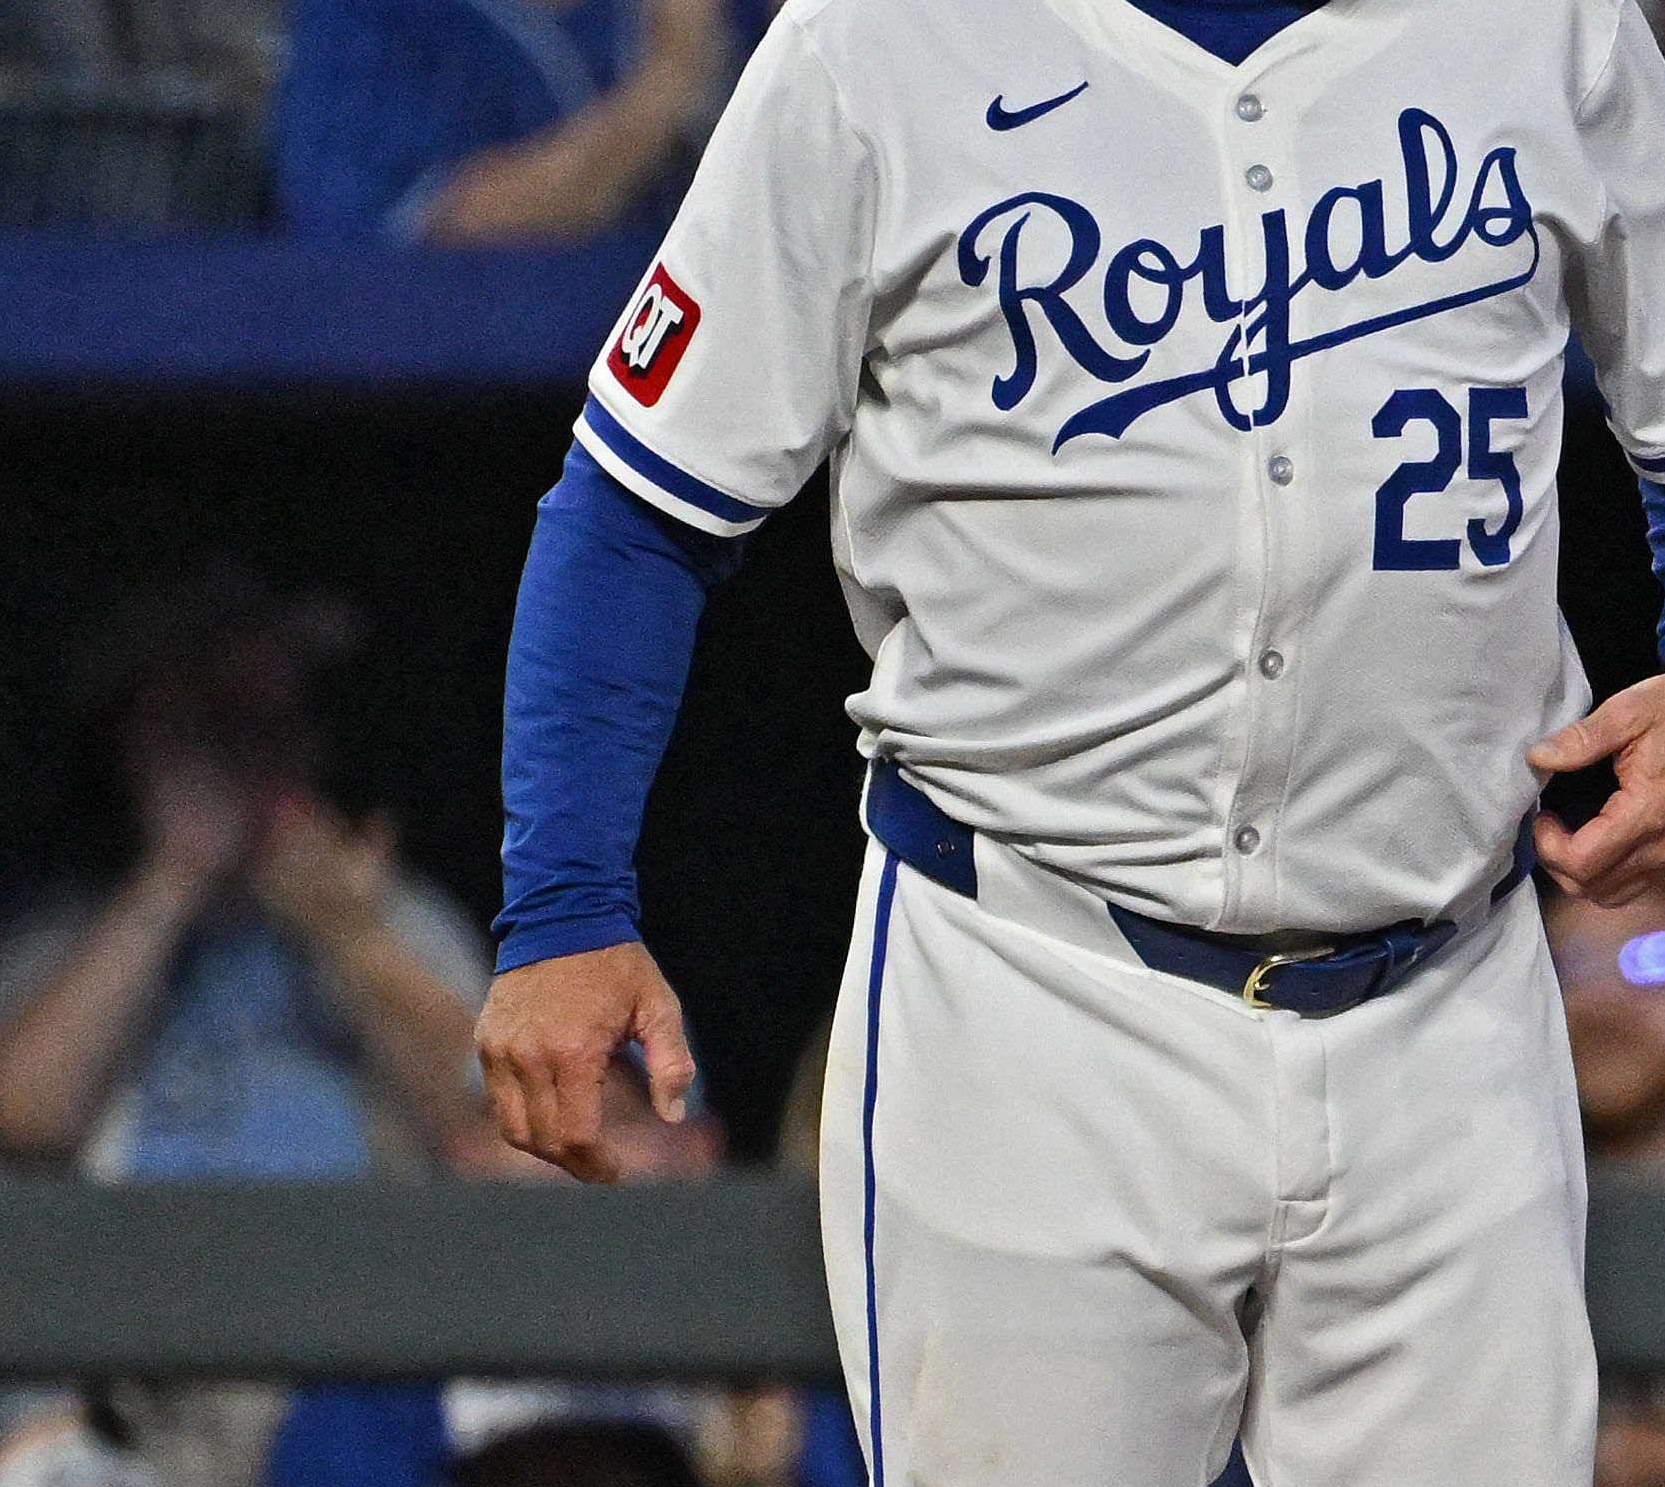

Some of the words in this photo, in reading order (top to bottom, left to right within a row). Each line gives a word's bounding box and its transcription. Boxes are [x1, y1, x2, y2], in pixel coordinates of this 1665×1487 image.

[621, 283, 685, 370] QT
[957, 107, 1540, 457] Royals
[1371, 387, 1529, 571] 25
